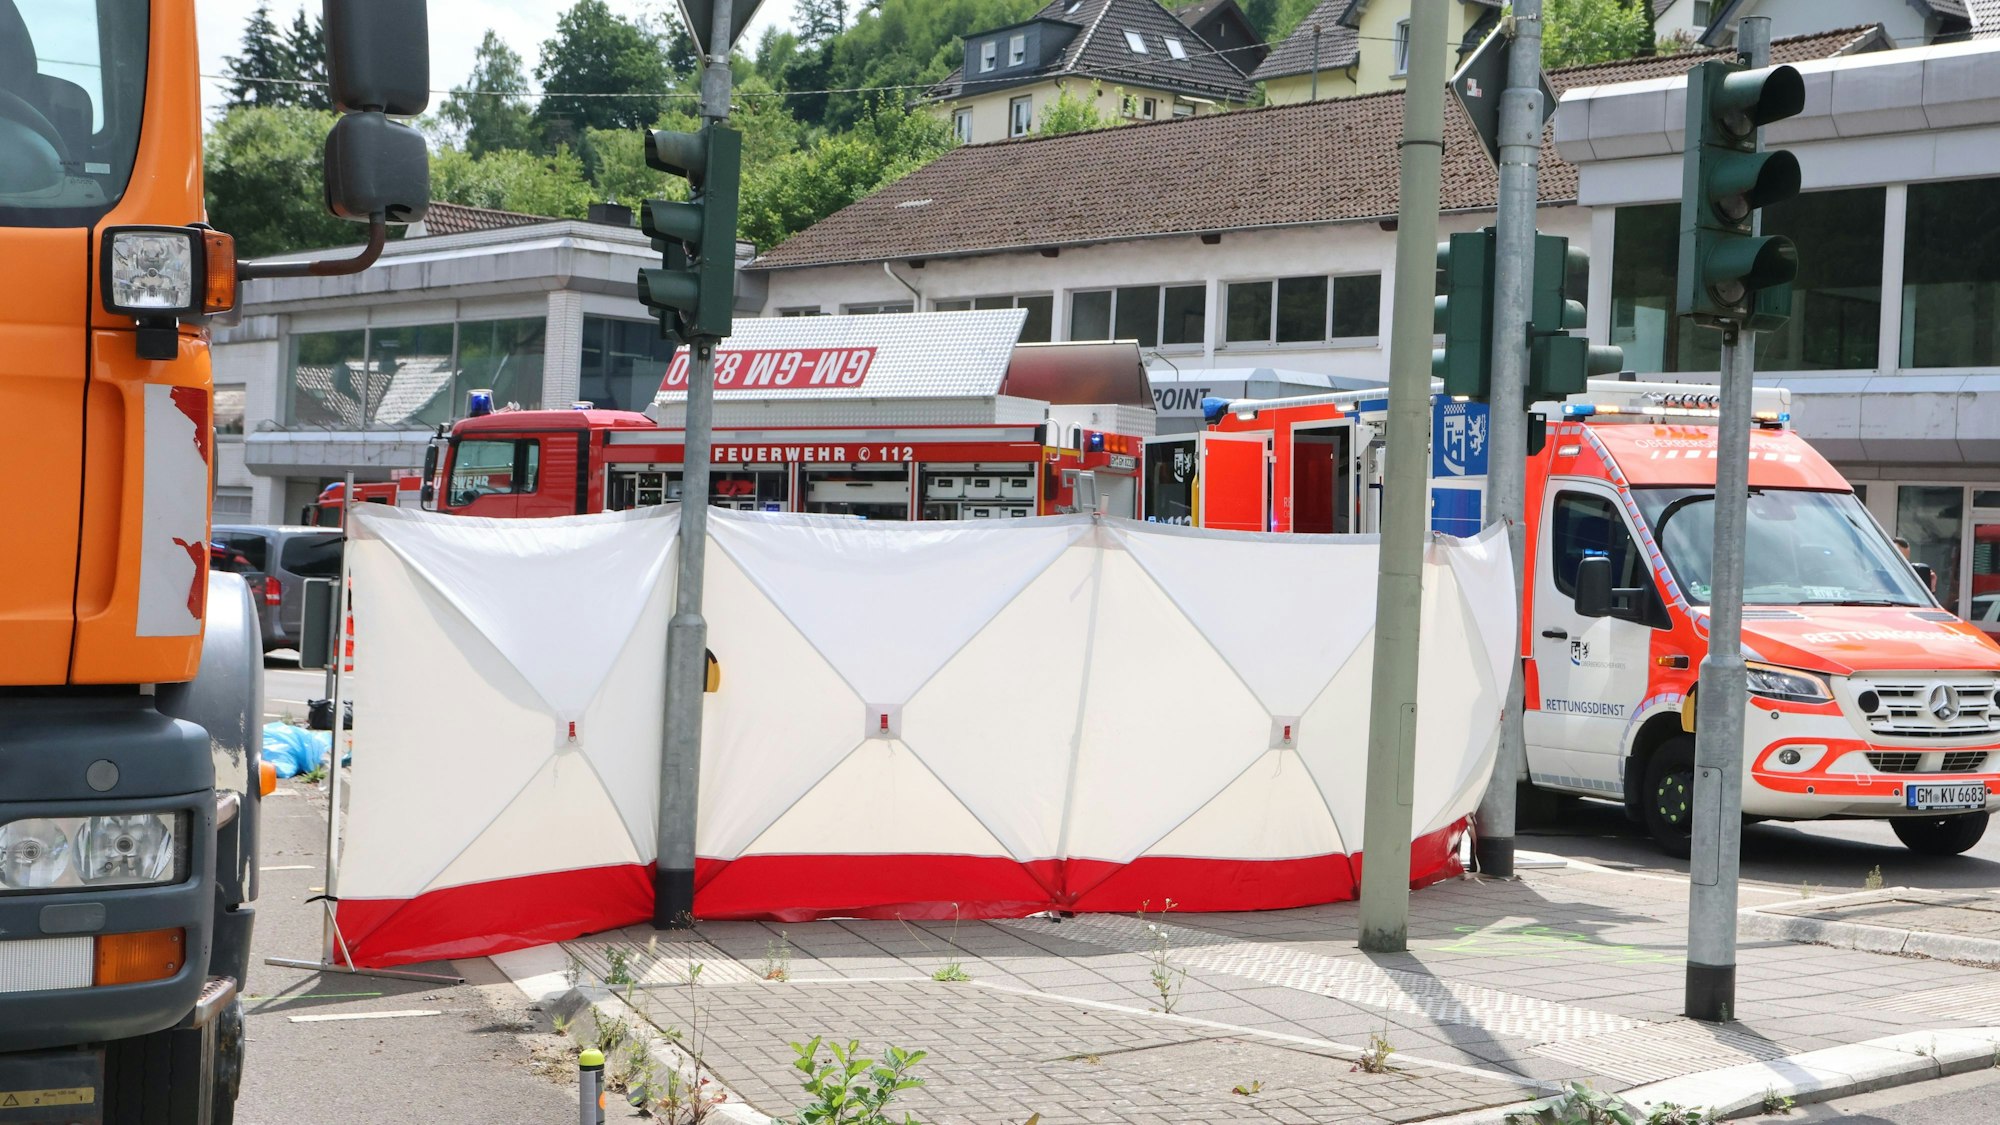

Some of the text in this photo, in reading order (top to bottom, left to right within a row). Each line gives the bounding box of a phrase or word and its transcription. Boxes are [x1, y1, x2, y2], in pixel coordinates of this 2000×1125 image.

[714, 446, 913, 462] FEUERWEHR 112
[1546, 698, 1625, 717] RETTUNGSDIENST
[1917, 787, 1984, 803] GM KV 6683
